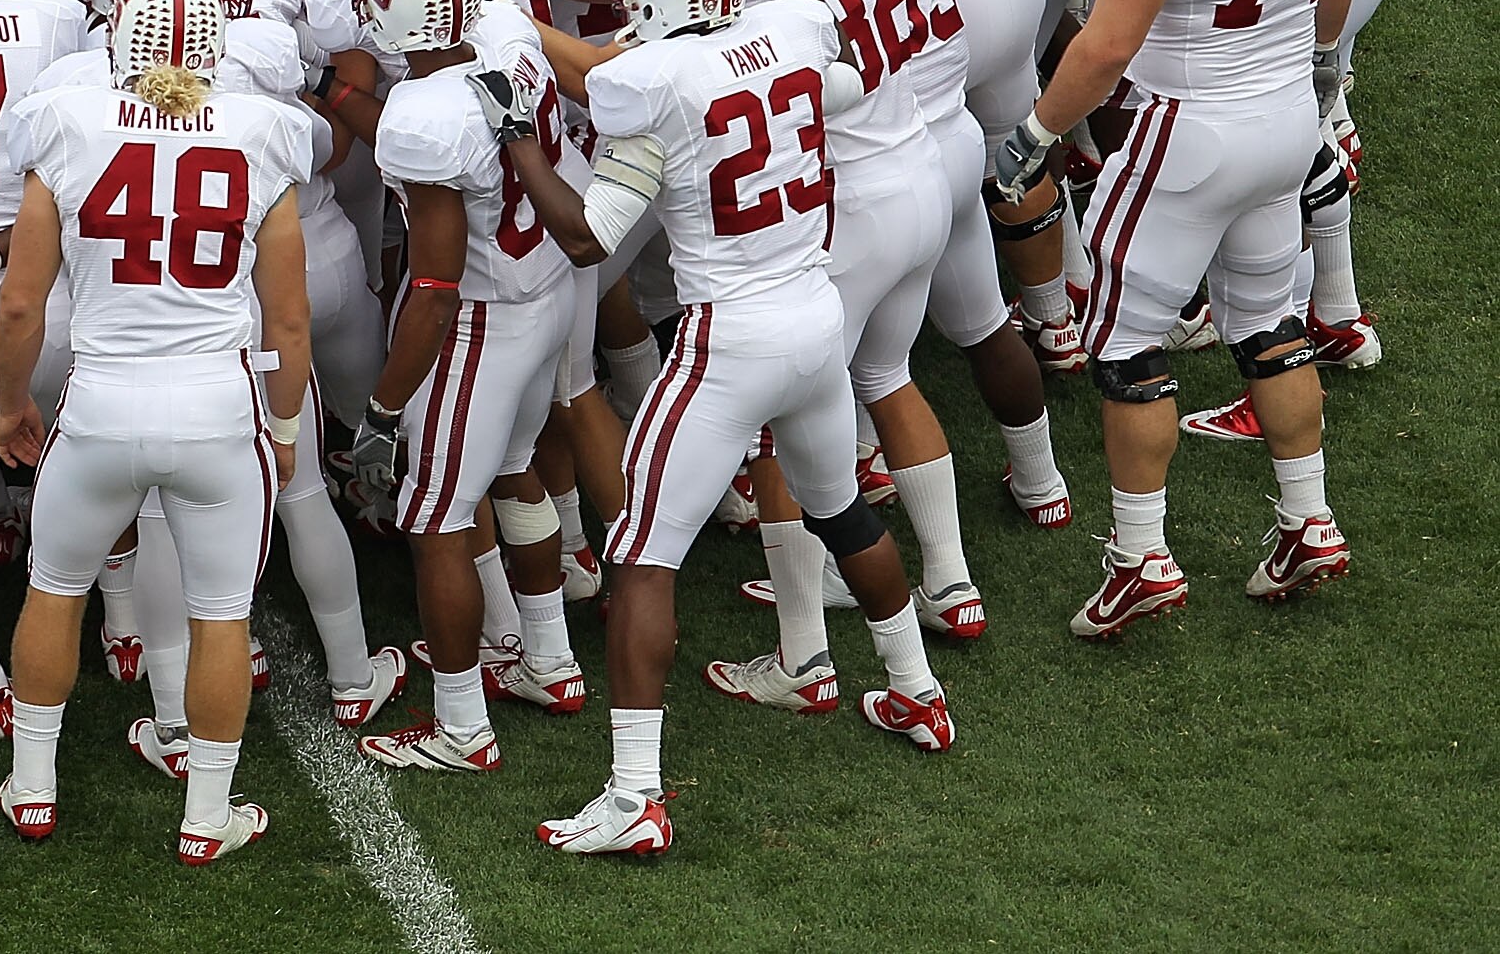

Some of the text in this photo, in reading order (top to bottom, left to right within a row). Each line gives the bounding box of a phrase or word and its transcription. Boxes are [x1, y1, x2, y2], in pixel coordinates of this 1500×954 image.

[185, 54, 202, 69] 48
[721, 35, 779, 78] YANCY
[704, 67, 826, 236] 23
[78, 142, 249, 289] 48
[1055, 329, 1080, 349] NIKE
[1038, 502, 1067, 524] NIKE
[564, 680, 586, 701] NIK
[20, 806, 53, 825] NIKE
